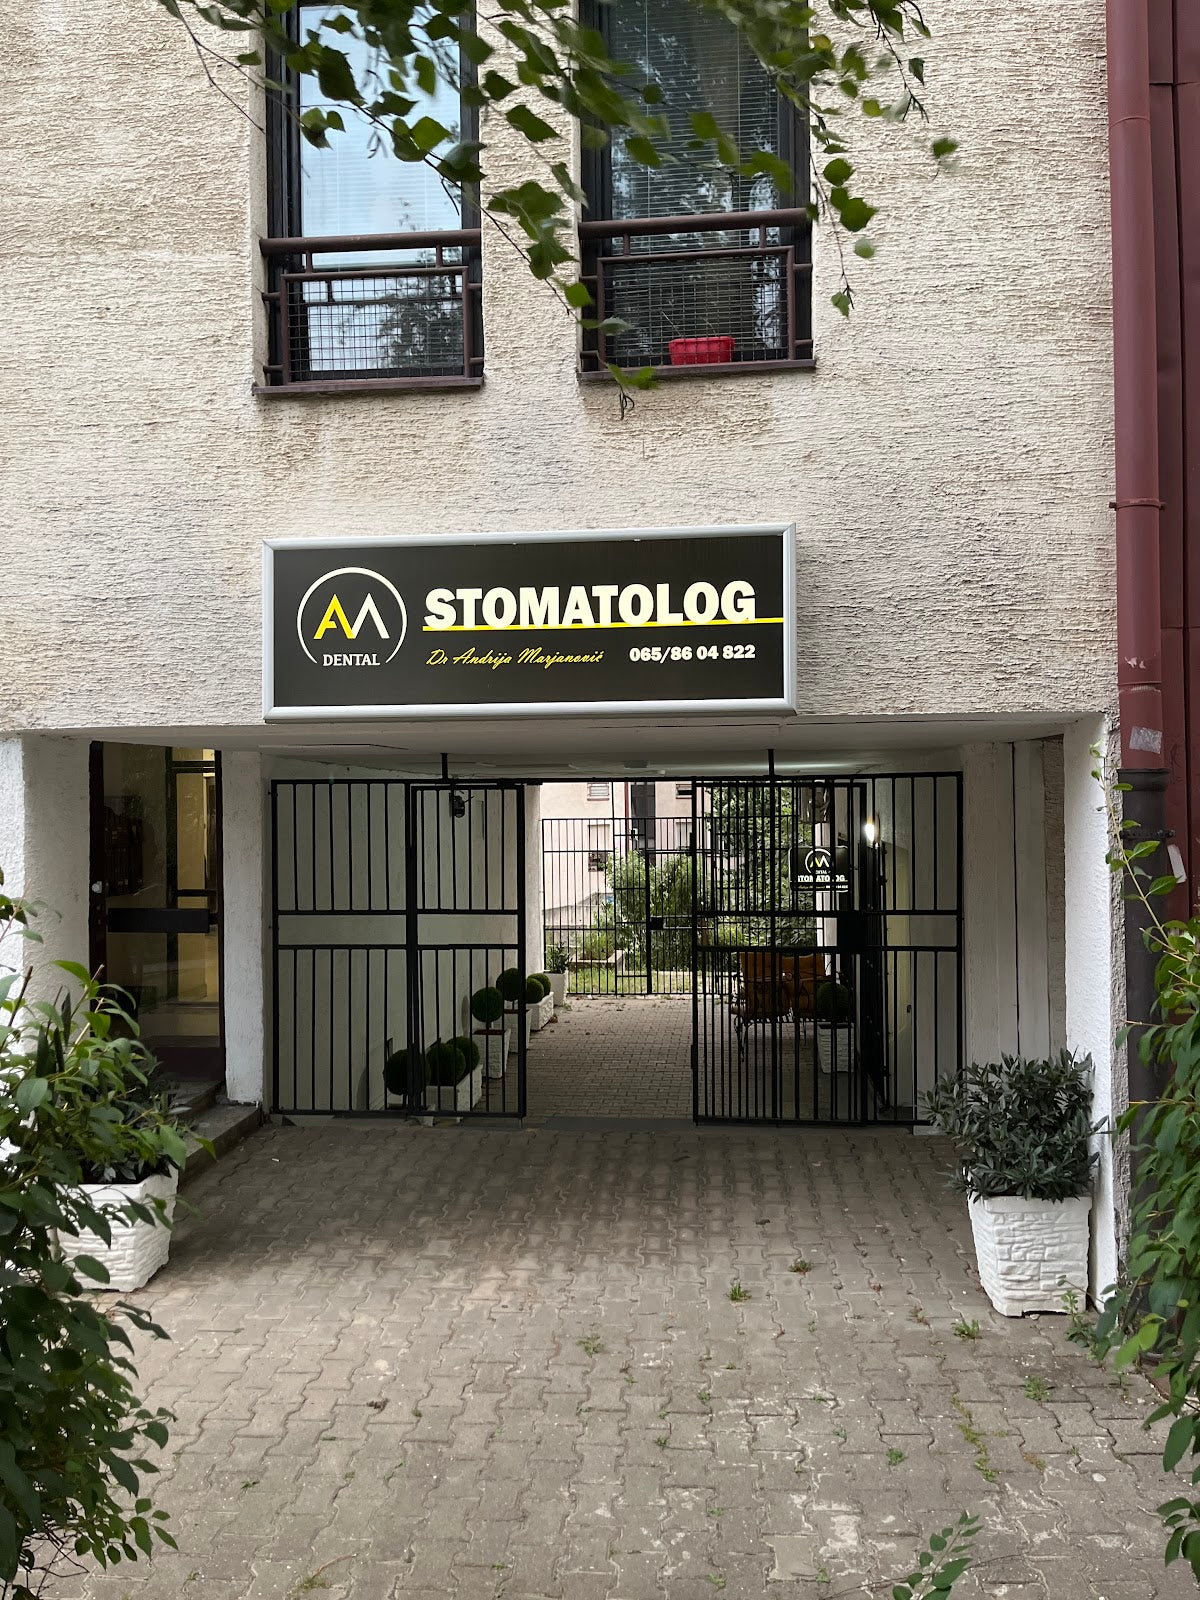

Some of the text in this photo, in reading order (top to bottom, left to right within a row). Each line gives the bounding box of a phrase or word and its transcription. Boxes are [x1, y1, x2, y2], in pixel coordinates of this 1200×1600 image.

[313, 592, 390, 640] AM
[423, 581, 757, 630] STOMATOLOG
[322, 653, 381, 667] DENTAL
[426, 646, 605, 670] Dr Andrija Marjanović
[629, 644, 756, 664] 065/86 04 822
